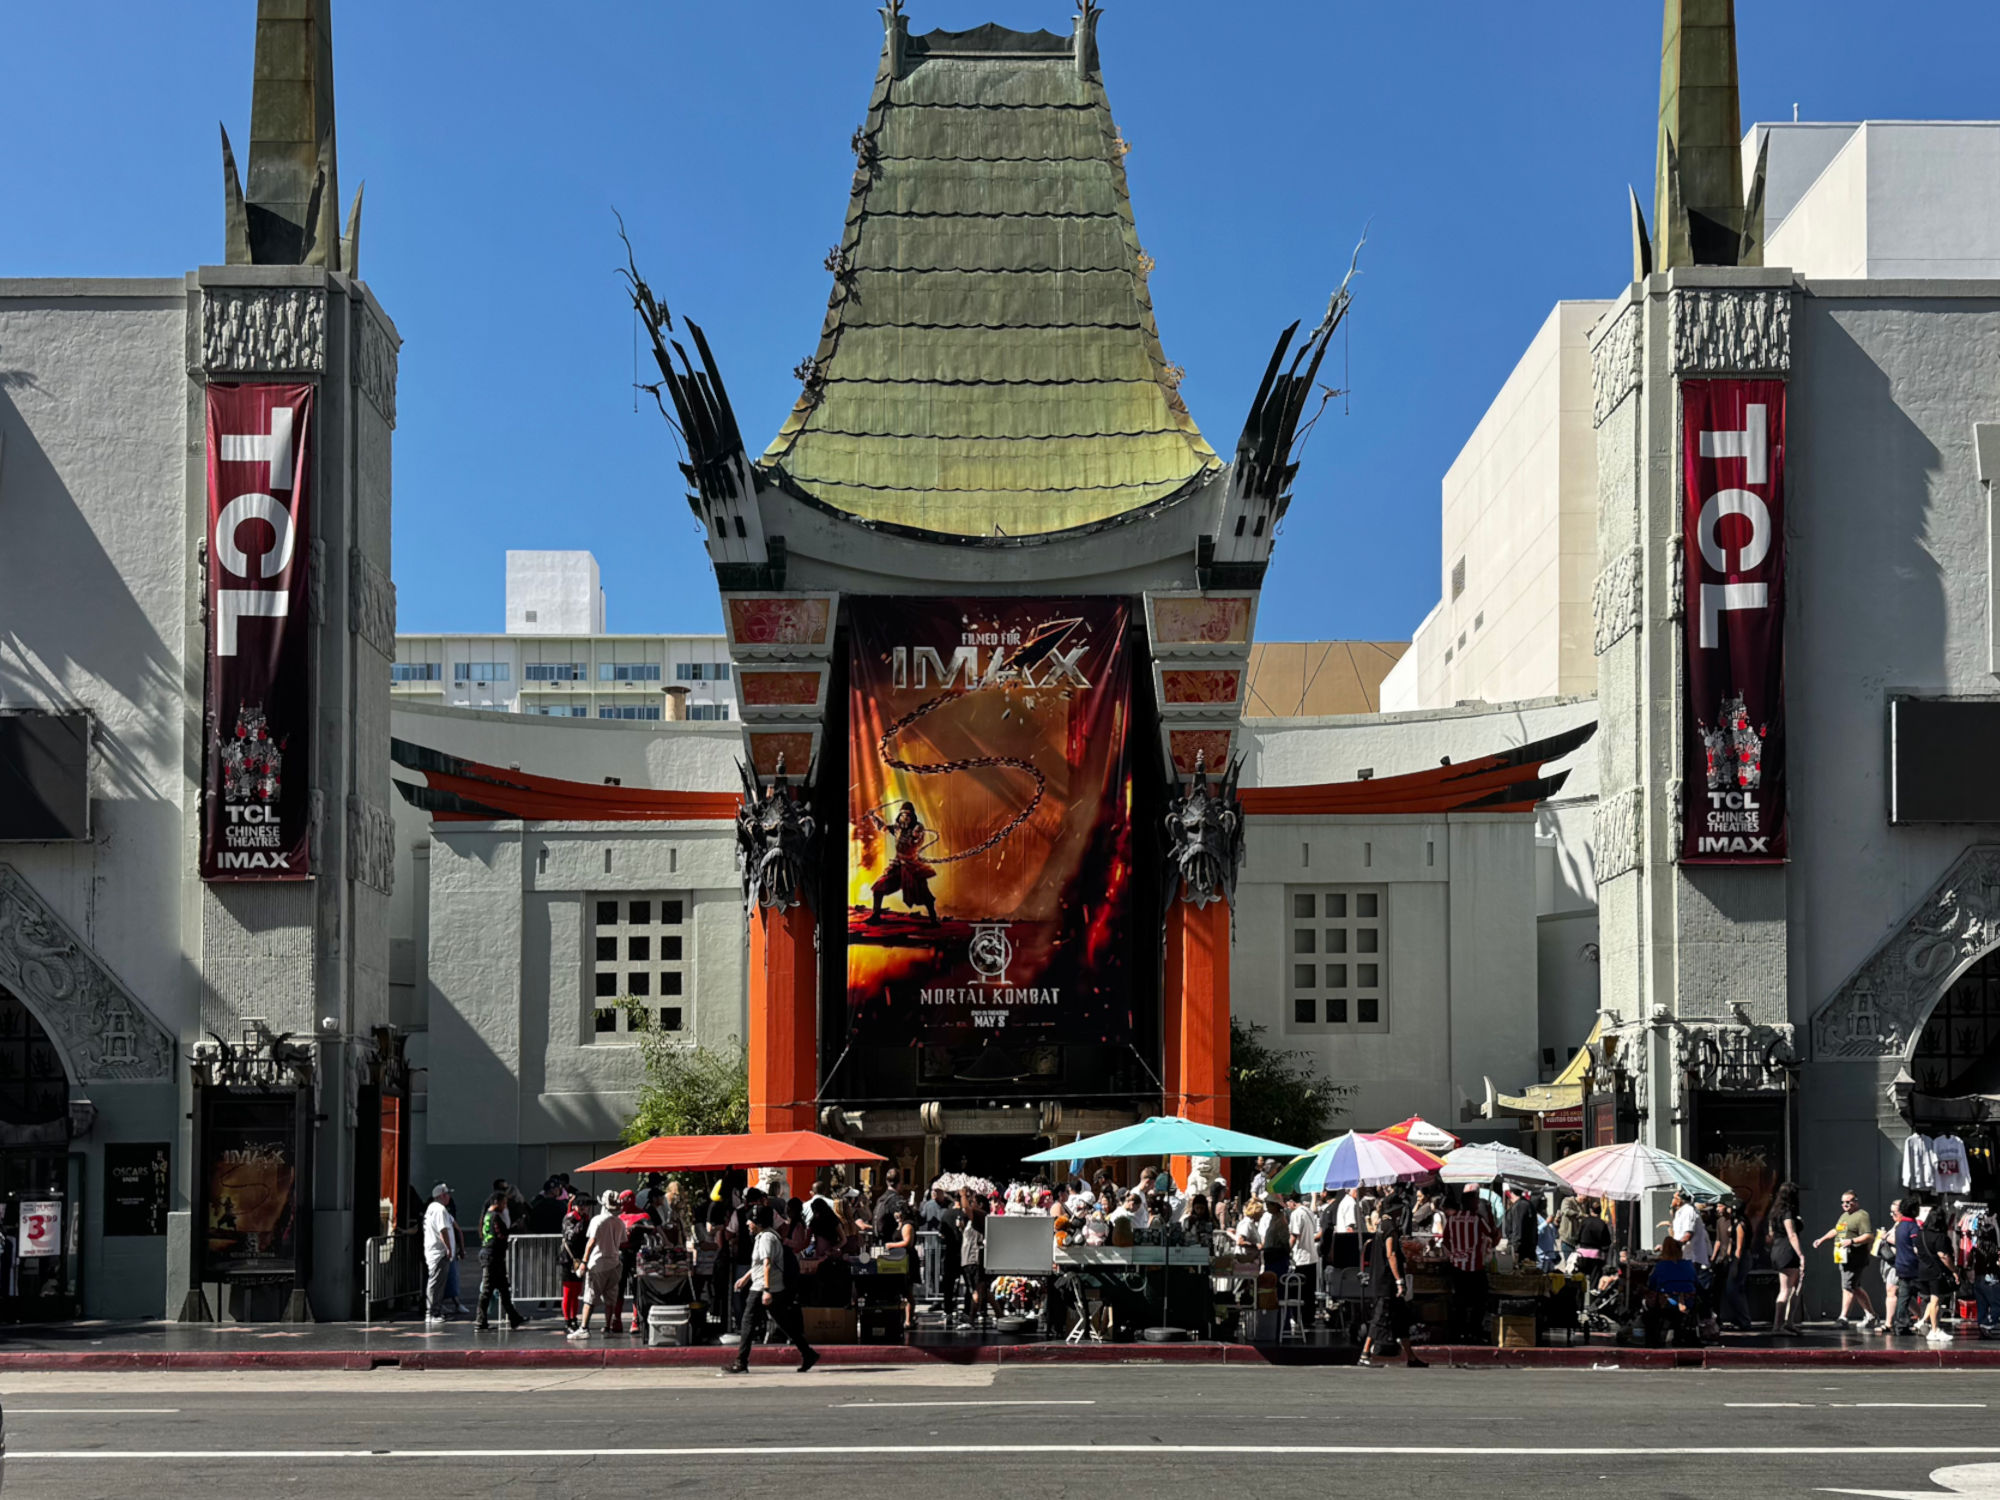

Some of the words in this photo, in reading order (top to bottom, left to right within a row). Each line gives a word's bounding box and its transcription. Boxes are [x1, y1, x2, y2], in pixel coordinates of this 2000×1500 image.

[216, 406, 293, 657] TCL
[1697, 403, 1771, 649] TCL
[961, 632, 998, 645] FILMED
[1001, 632, 1021, 645] FOR
[892, 646, 1093, 689] IMAX
[1707, 791, 1760, 810] TCL
[225, 804, 281, 824] TCL
[1707, 811, 1759, 822] CHINESE
[225, 825, 280, 837] CHINESE
[1707, 822, 1760, 833] THEATRES
[226, 836, 281, 847] THEATRES
[1698, 836, 1769, 853] IMAX
[217, 851, 291, 869] IMAX
[920, 988, 986, 1005] MORTAL
[992, 988, 1060, 1005] KOMBAT
[974, 1015, 995, 1027] MAY
[113, 1167, 149, 1177] OSCARS
